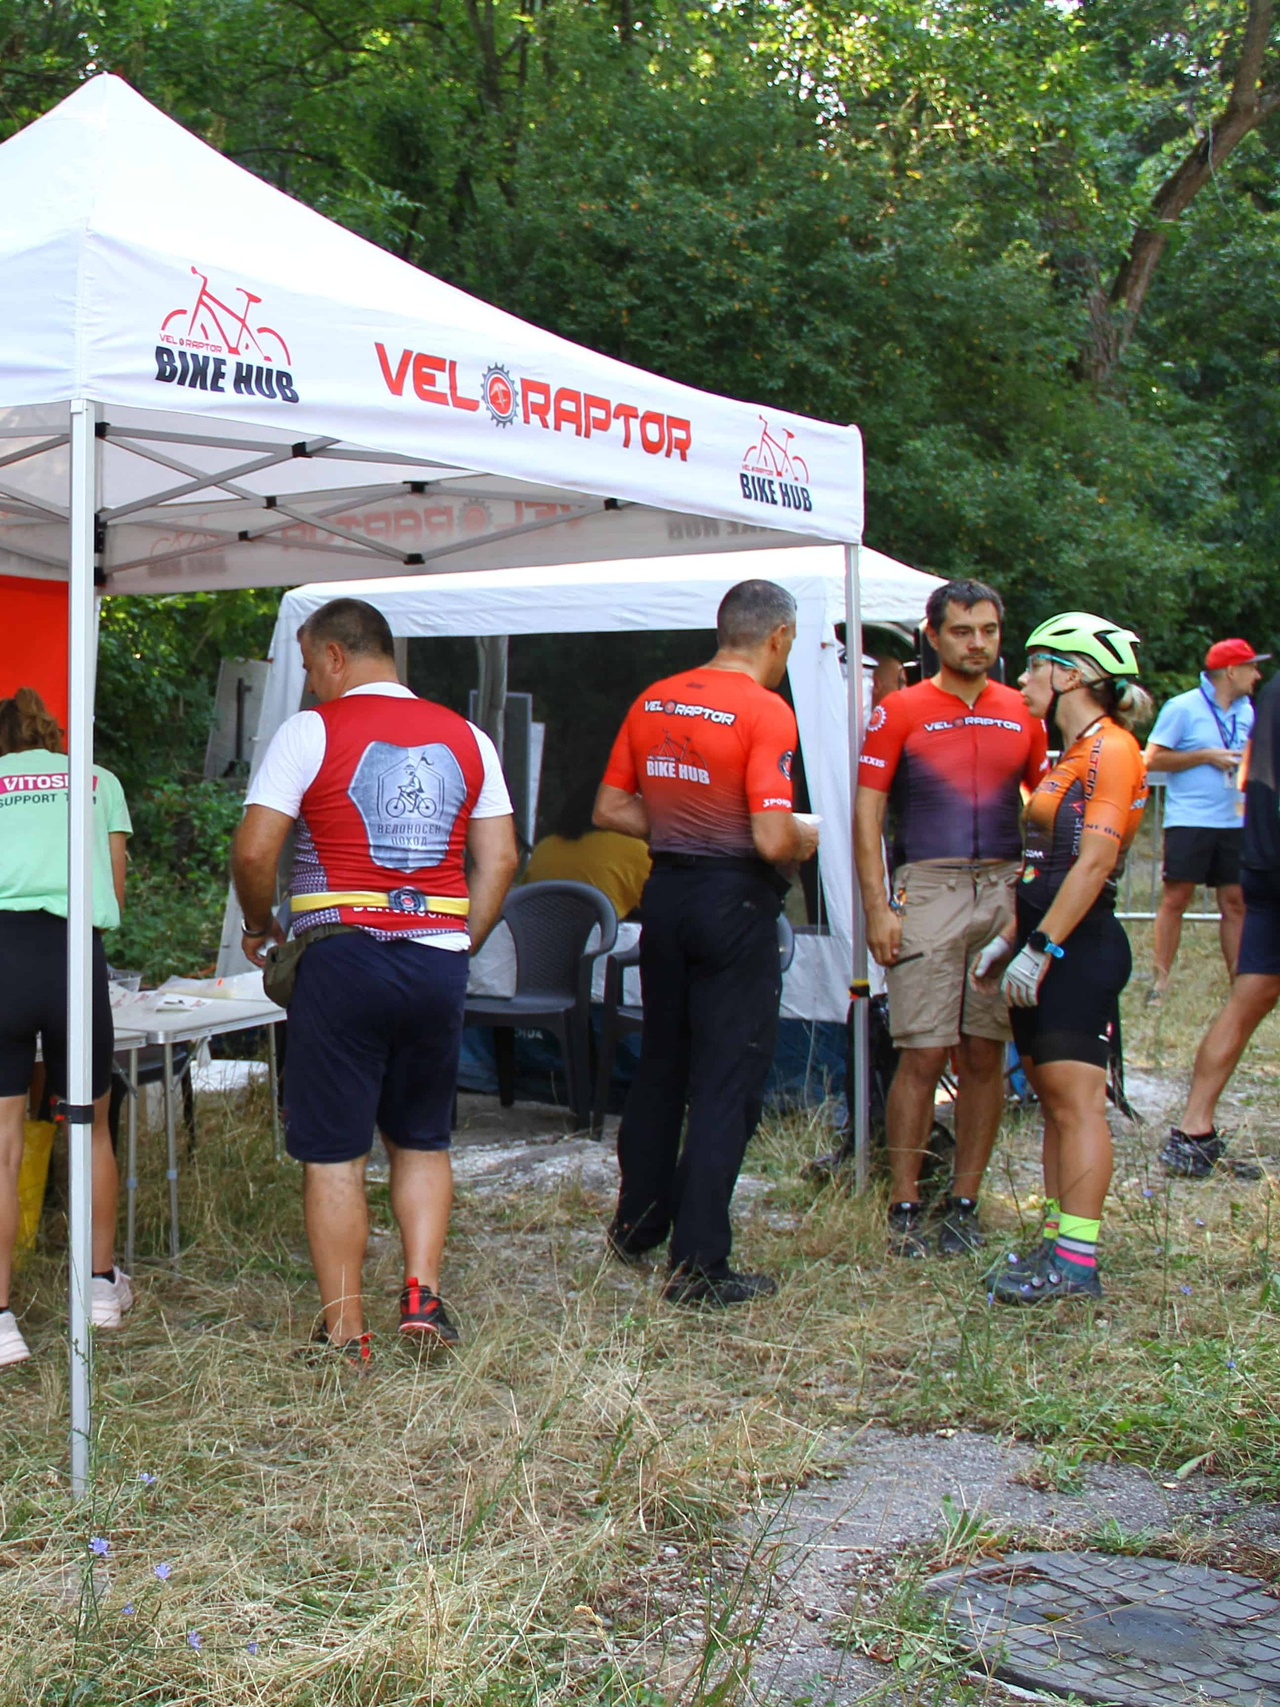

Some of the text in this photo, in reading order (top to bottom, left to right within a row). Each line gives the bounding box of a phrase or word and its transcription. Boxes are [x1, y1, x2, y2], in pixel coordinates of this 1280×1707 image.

[154, 345, 300, 404] BIKE HUB
[739, 471, 813, 512] BIKE HUB
[646, 760, 710, 785] BIKE HUB
[3, 775, 68, 791] VITOS
[376, 823, 442, 835] ВЕЛОНОСЕН
[391, 835, 428, 847] ПОХОД
